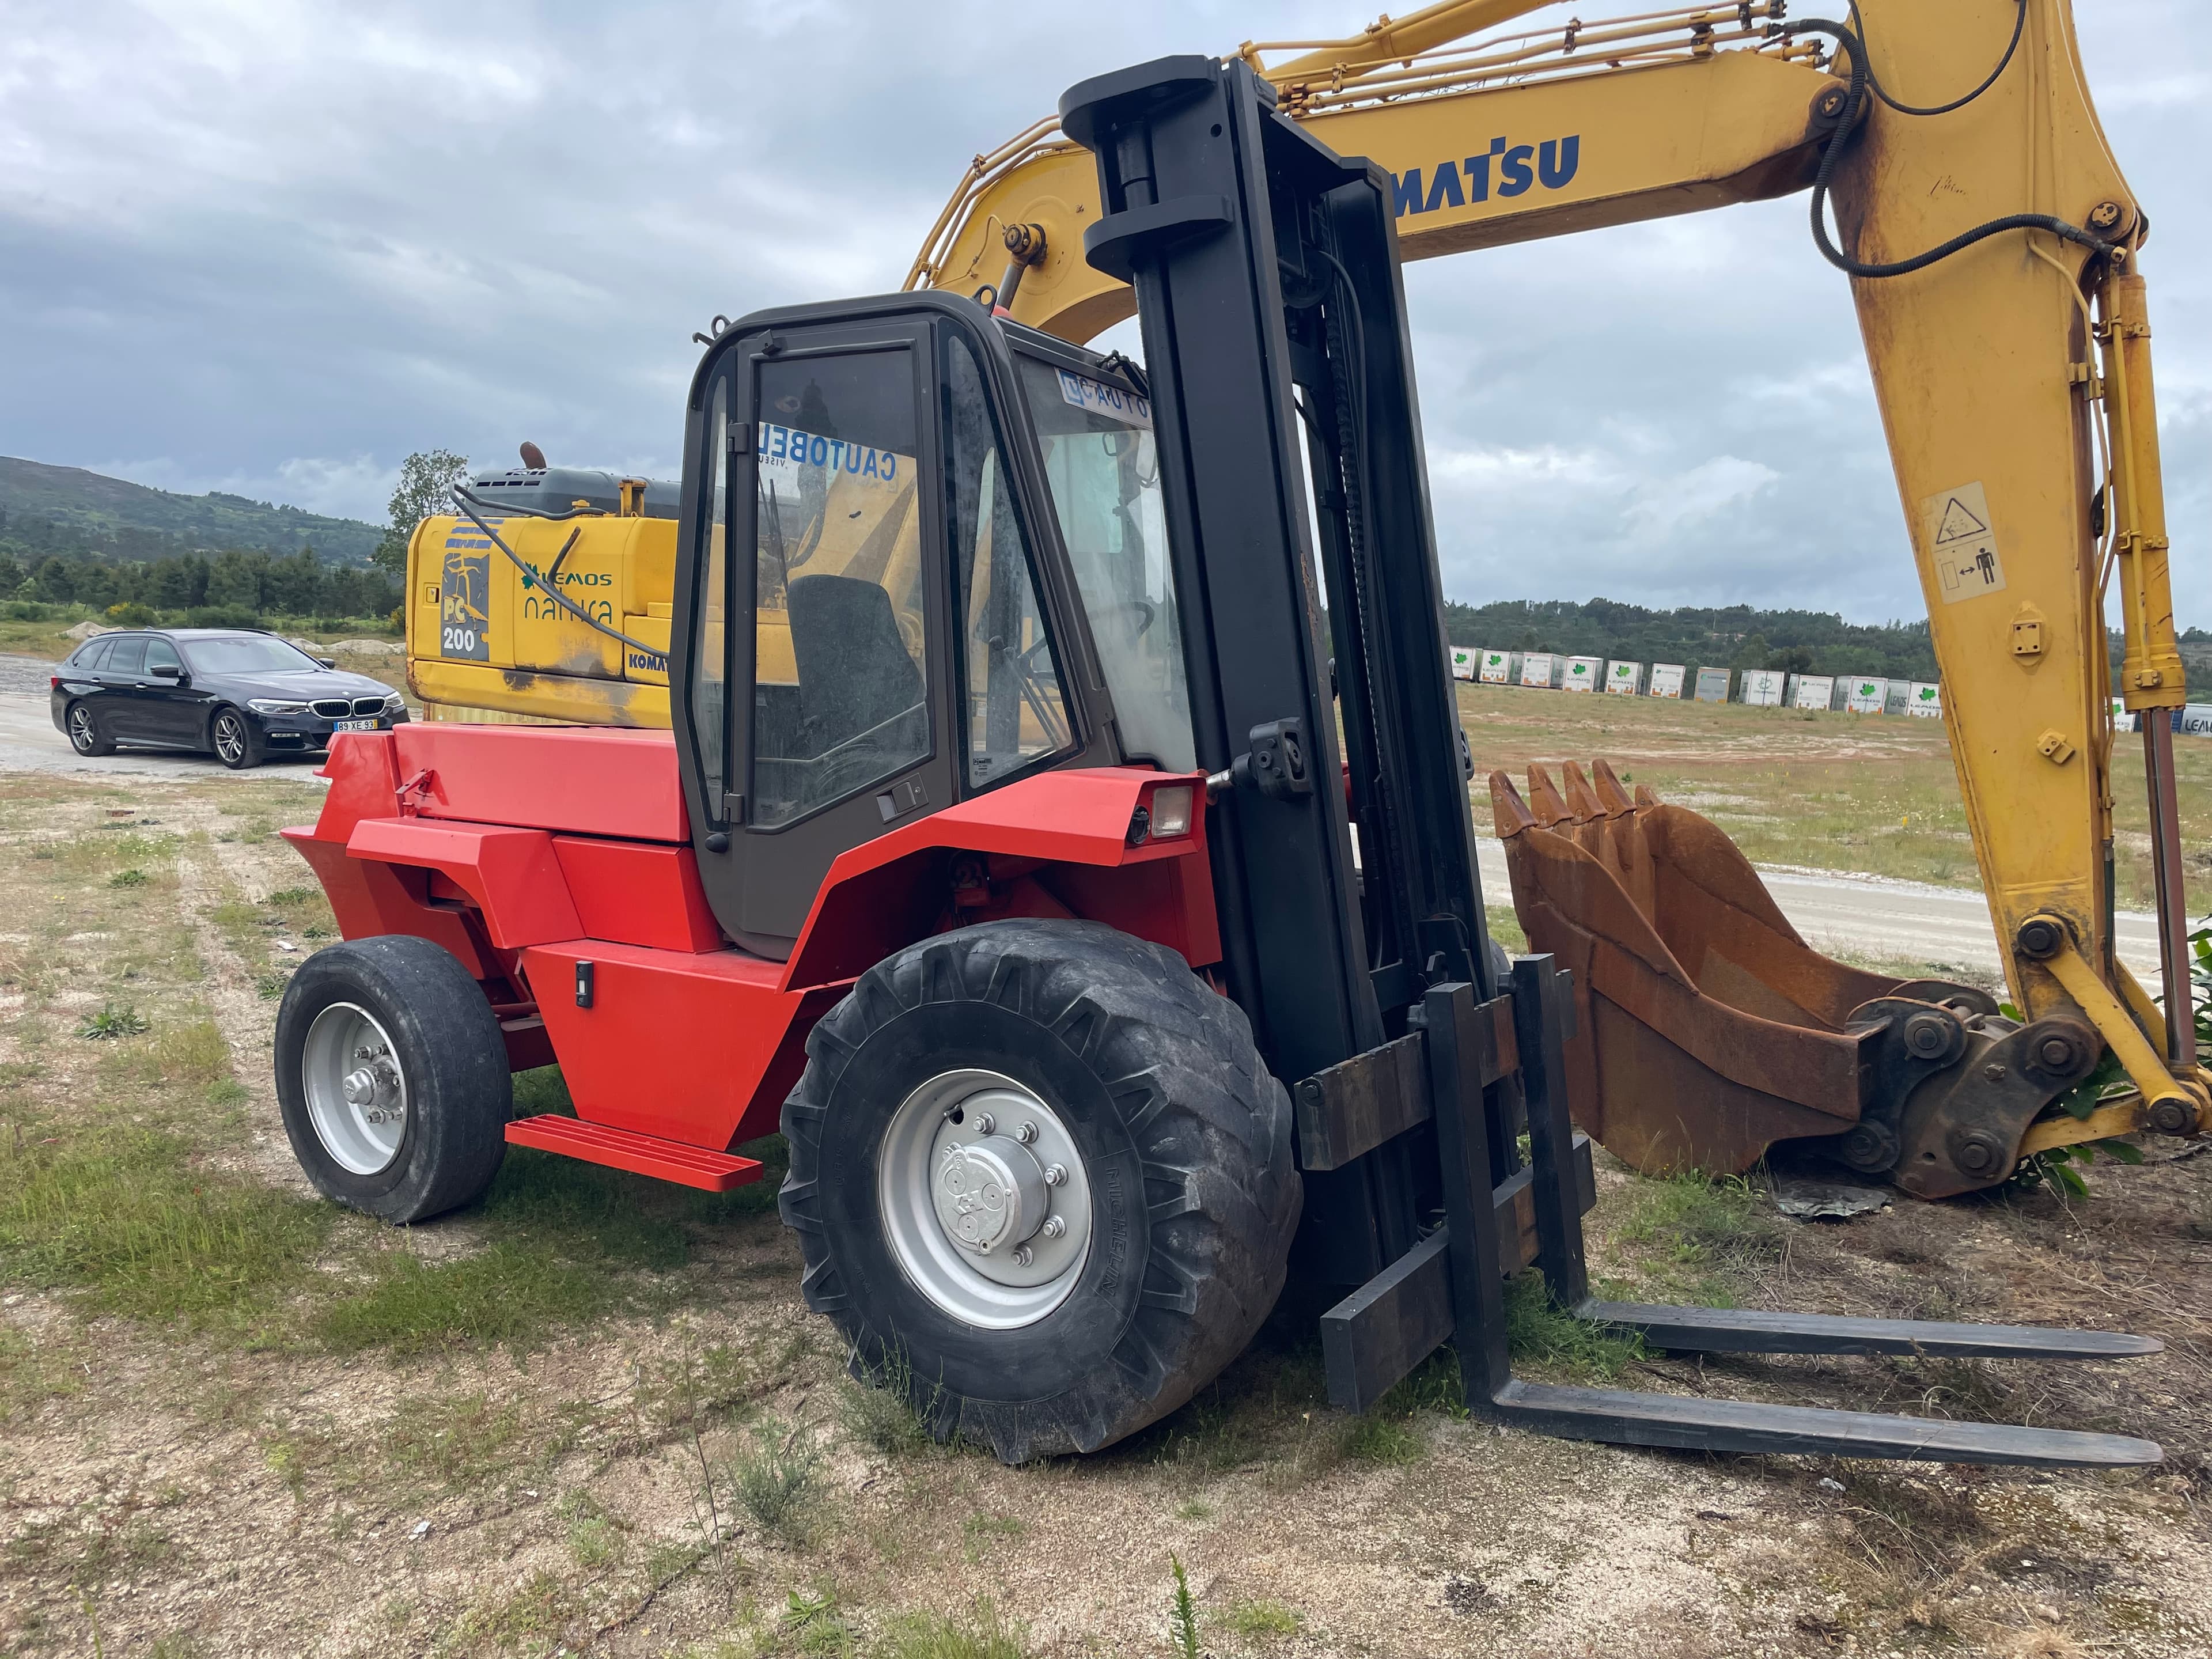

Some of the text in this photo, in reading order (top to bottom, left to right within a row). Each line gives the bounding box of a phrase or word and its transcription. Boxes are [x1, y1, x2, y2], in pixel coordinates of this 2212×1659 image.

[541, 572, 612, 586] LEMOS
[444, 627, 475, 652] 200
[339, 721, 373, 731] 89 XE 93
[1101, 1165, 1128, 1297] MICHELIN
